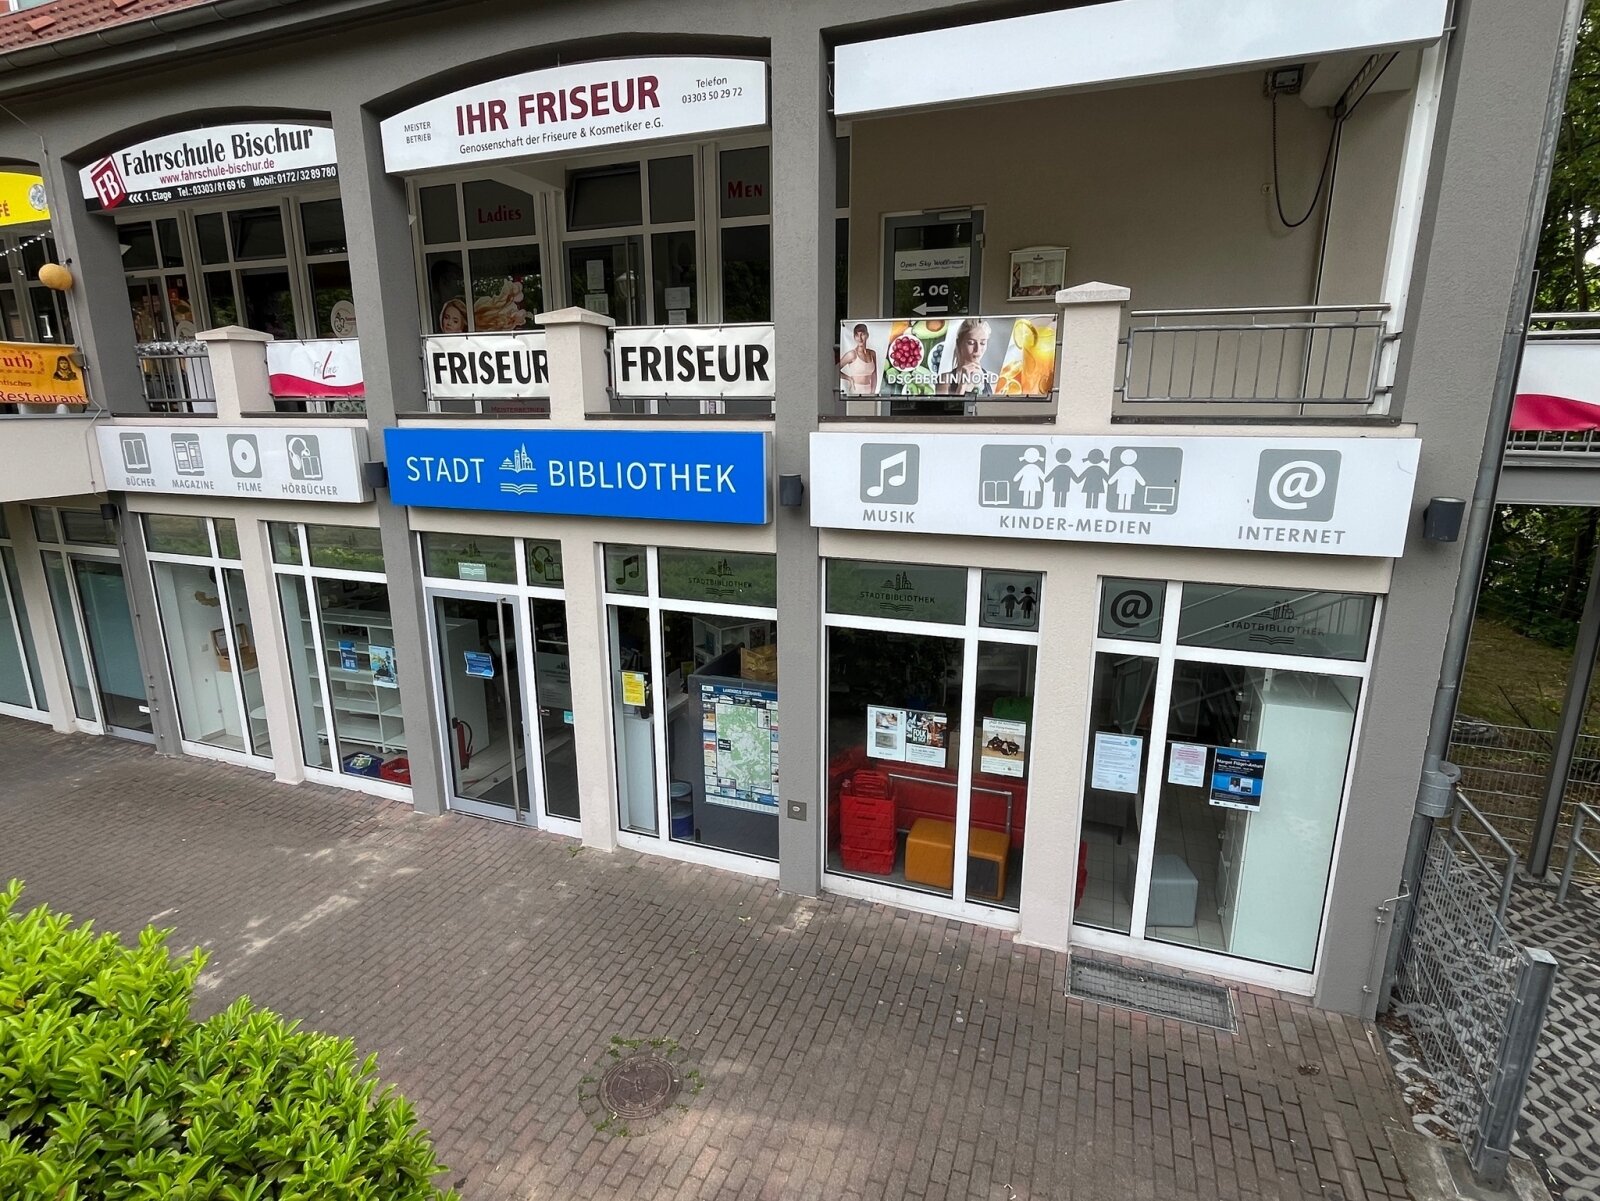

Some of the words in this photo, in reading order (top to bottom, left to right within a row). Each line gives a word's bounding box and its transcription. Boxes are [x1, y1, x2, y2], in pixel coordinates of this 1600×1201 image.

[696, 76, 728, 88] Telefon
[681, 92, 707, 104] 03303
[708, 90, 719, 100] 50
[720, 88, 731, 99] 29
[732, 86, 743, 97] 72
[456, 99, 509, 136] IHR
[518, 75, 660, 127] FRISEUR
[404, 121, 431, 133] MEISTER
[460, 136, 523, 154] Genossenschaft
[526, 134, 540, 145] der
[542, 131, 577, 143] Friseure
[580, 127, 587, 138] &
[589, 120, 642, 137] Kosmetiker
[645, 117, 664, 129] e.G.
[406, 133, 432, 144] BETRIEB
[122, 138, 225, 177] Fahrschule
[231, 127, 313, 160] Bischur
[160, 158, 275, 184] www.fahrschule-bischur.de
[95, 170, 120, 207] FB
[152, 190, 172, 202] Etage
[253, 174, 277, 187] Mobil:
[912, 285, 925, 297] 2.
[928, 284, 949, 296] OG
[432, 349, 549, 385] FRISEUR
[620, 344, 770, 383] FRISEUR
[887, 373, 912, 385] DSC
[914, 373, 958, 385] BERLIN
[961, 373, 999, 385] NORD
[126, 475, 157, 487] BÜCHER
[405, 456, 485, 484] STADT
[548, 459, 737, 494] BIBLIOTHEK
[172, 479, 215, 490] MAGAZINE
[237, 481, 262, 493] FILME
[281, 482, 339, 496] HÖRBÜCHER
[862, 508, 916, 525] MUSIK
[998, 514, 1153, 536] KINDER-MEDIEN
[1237, 525, 1347, 546] INTERNET
[688, 577, 752, 588] STADTBIBLIOTHEK
[860, 591, 935, 605] STADTBIBLIOTHEK
